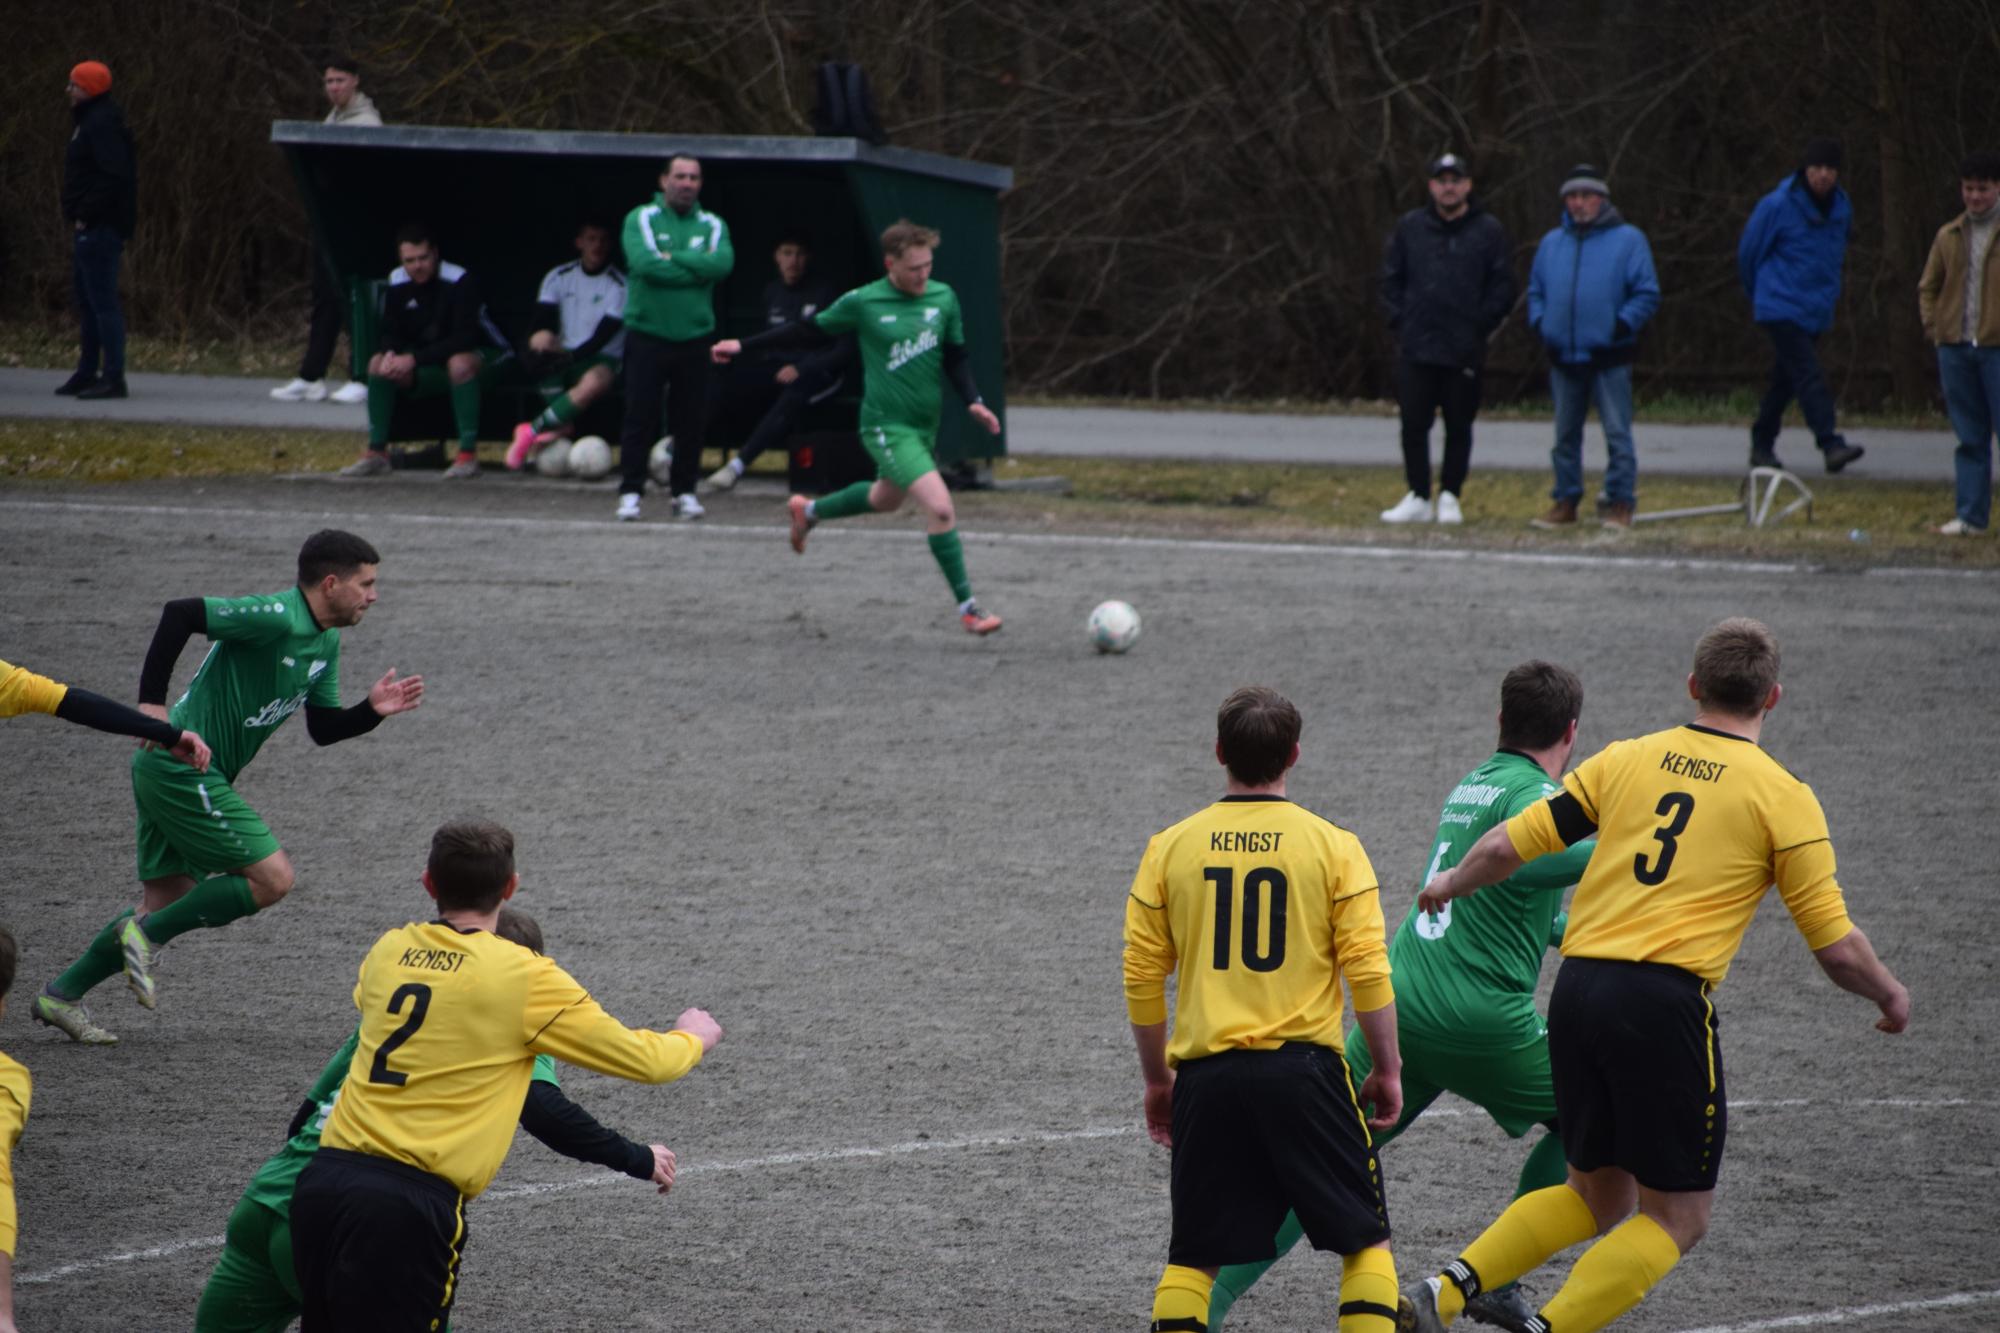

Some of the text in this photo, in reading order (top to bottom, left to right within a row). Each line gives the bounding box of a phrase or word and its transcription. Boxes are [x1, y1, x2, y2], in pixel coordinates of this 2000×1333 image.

[1659, 750, 1729, 784] KENGST
[1210, 831, 1283, 853] KENGST
[1633, 791, 1695, 886] 3
[1203, 866, 1288, 973] 10
[398, 947, 469, 973] KENGST
[368, 982, 432, 1087] 2
